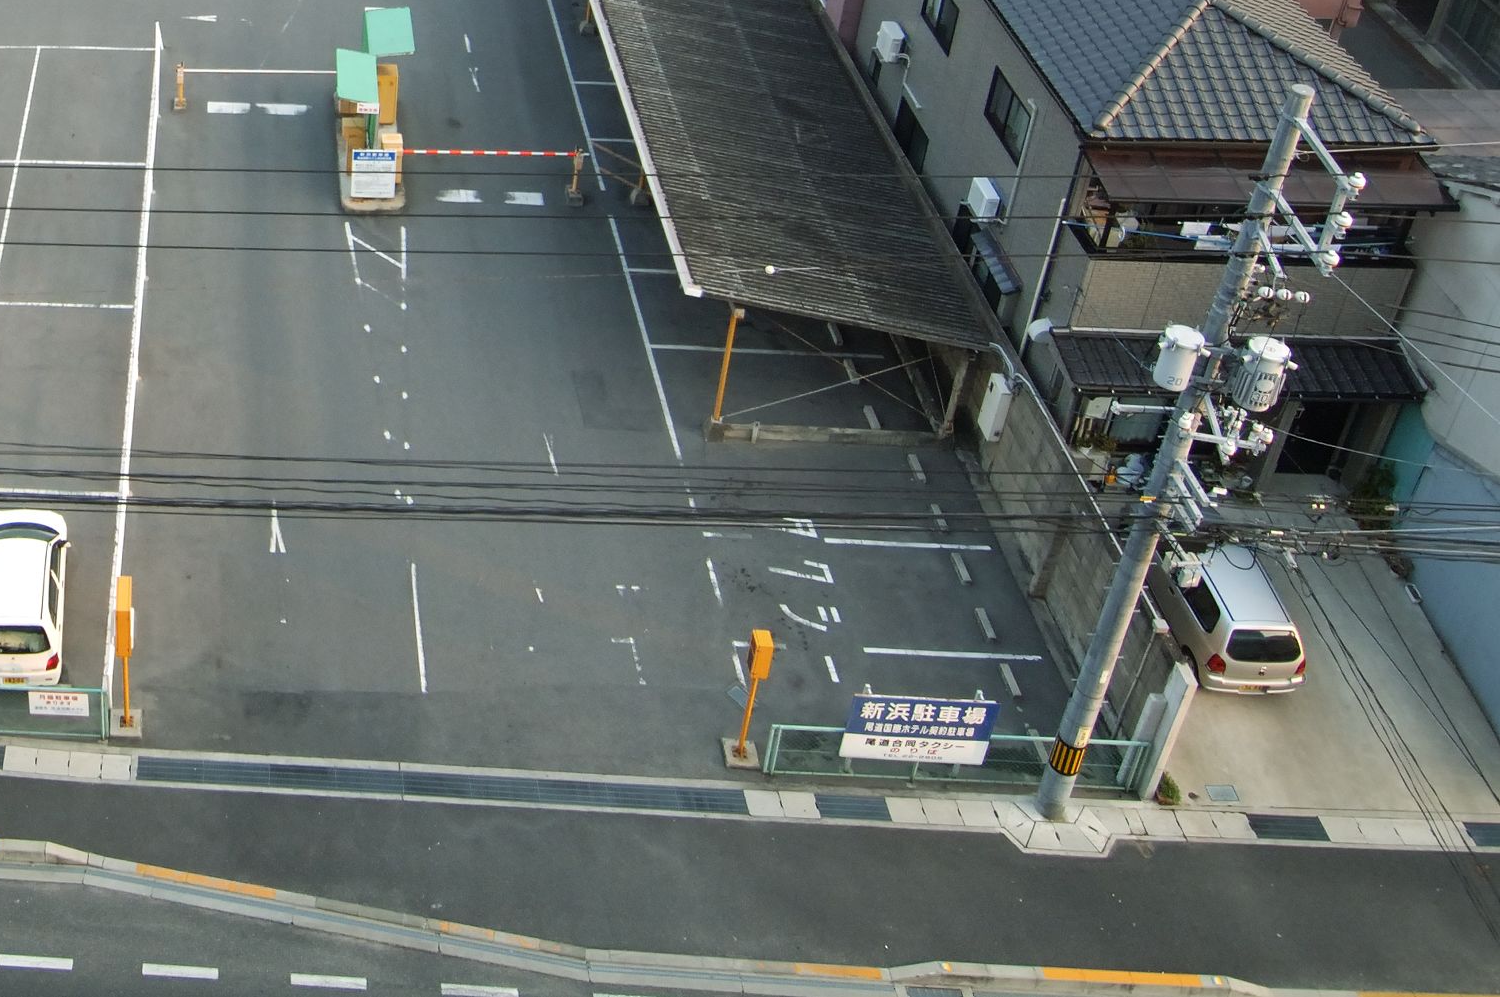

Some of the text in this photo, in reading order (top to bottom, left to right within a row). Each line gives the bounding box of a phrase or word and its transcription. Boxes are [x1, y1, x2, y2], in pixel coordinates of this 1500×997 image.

[1166, 376, 1183, 385] 20
[860, 701, 988, 725] 新浜駐車場
[864, 737, 966, 751] 尾道合同タクシー
